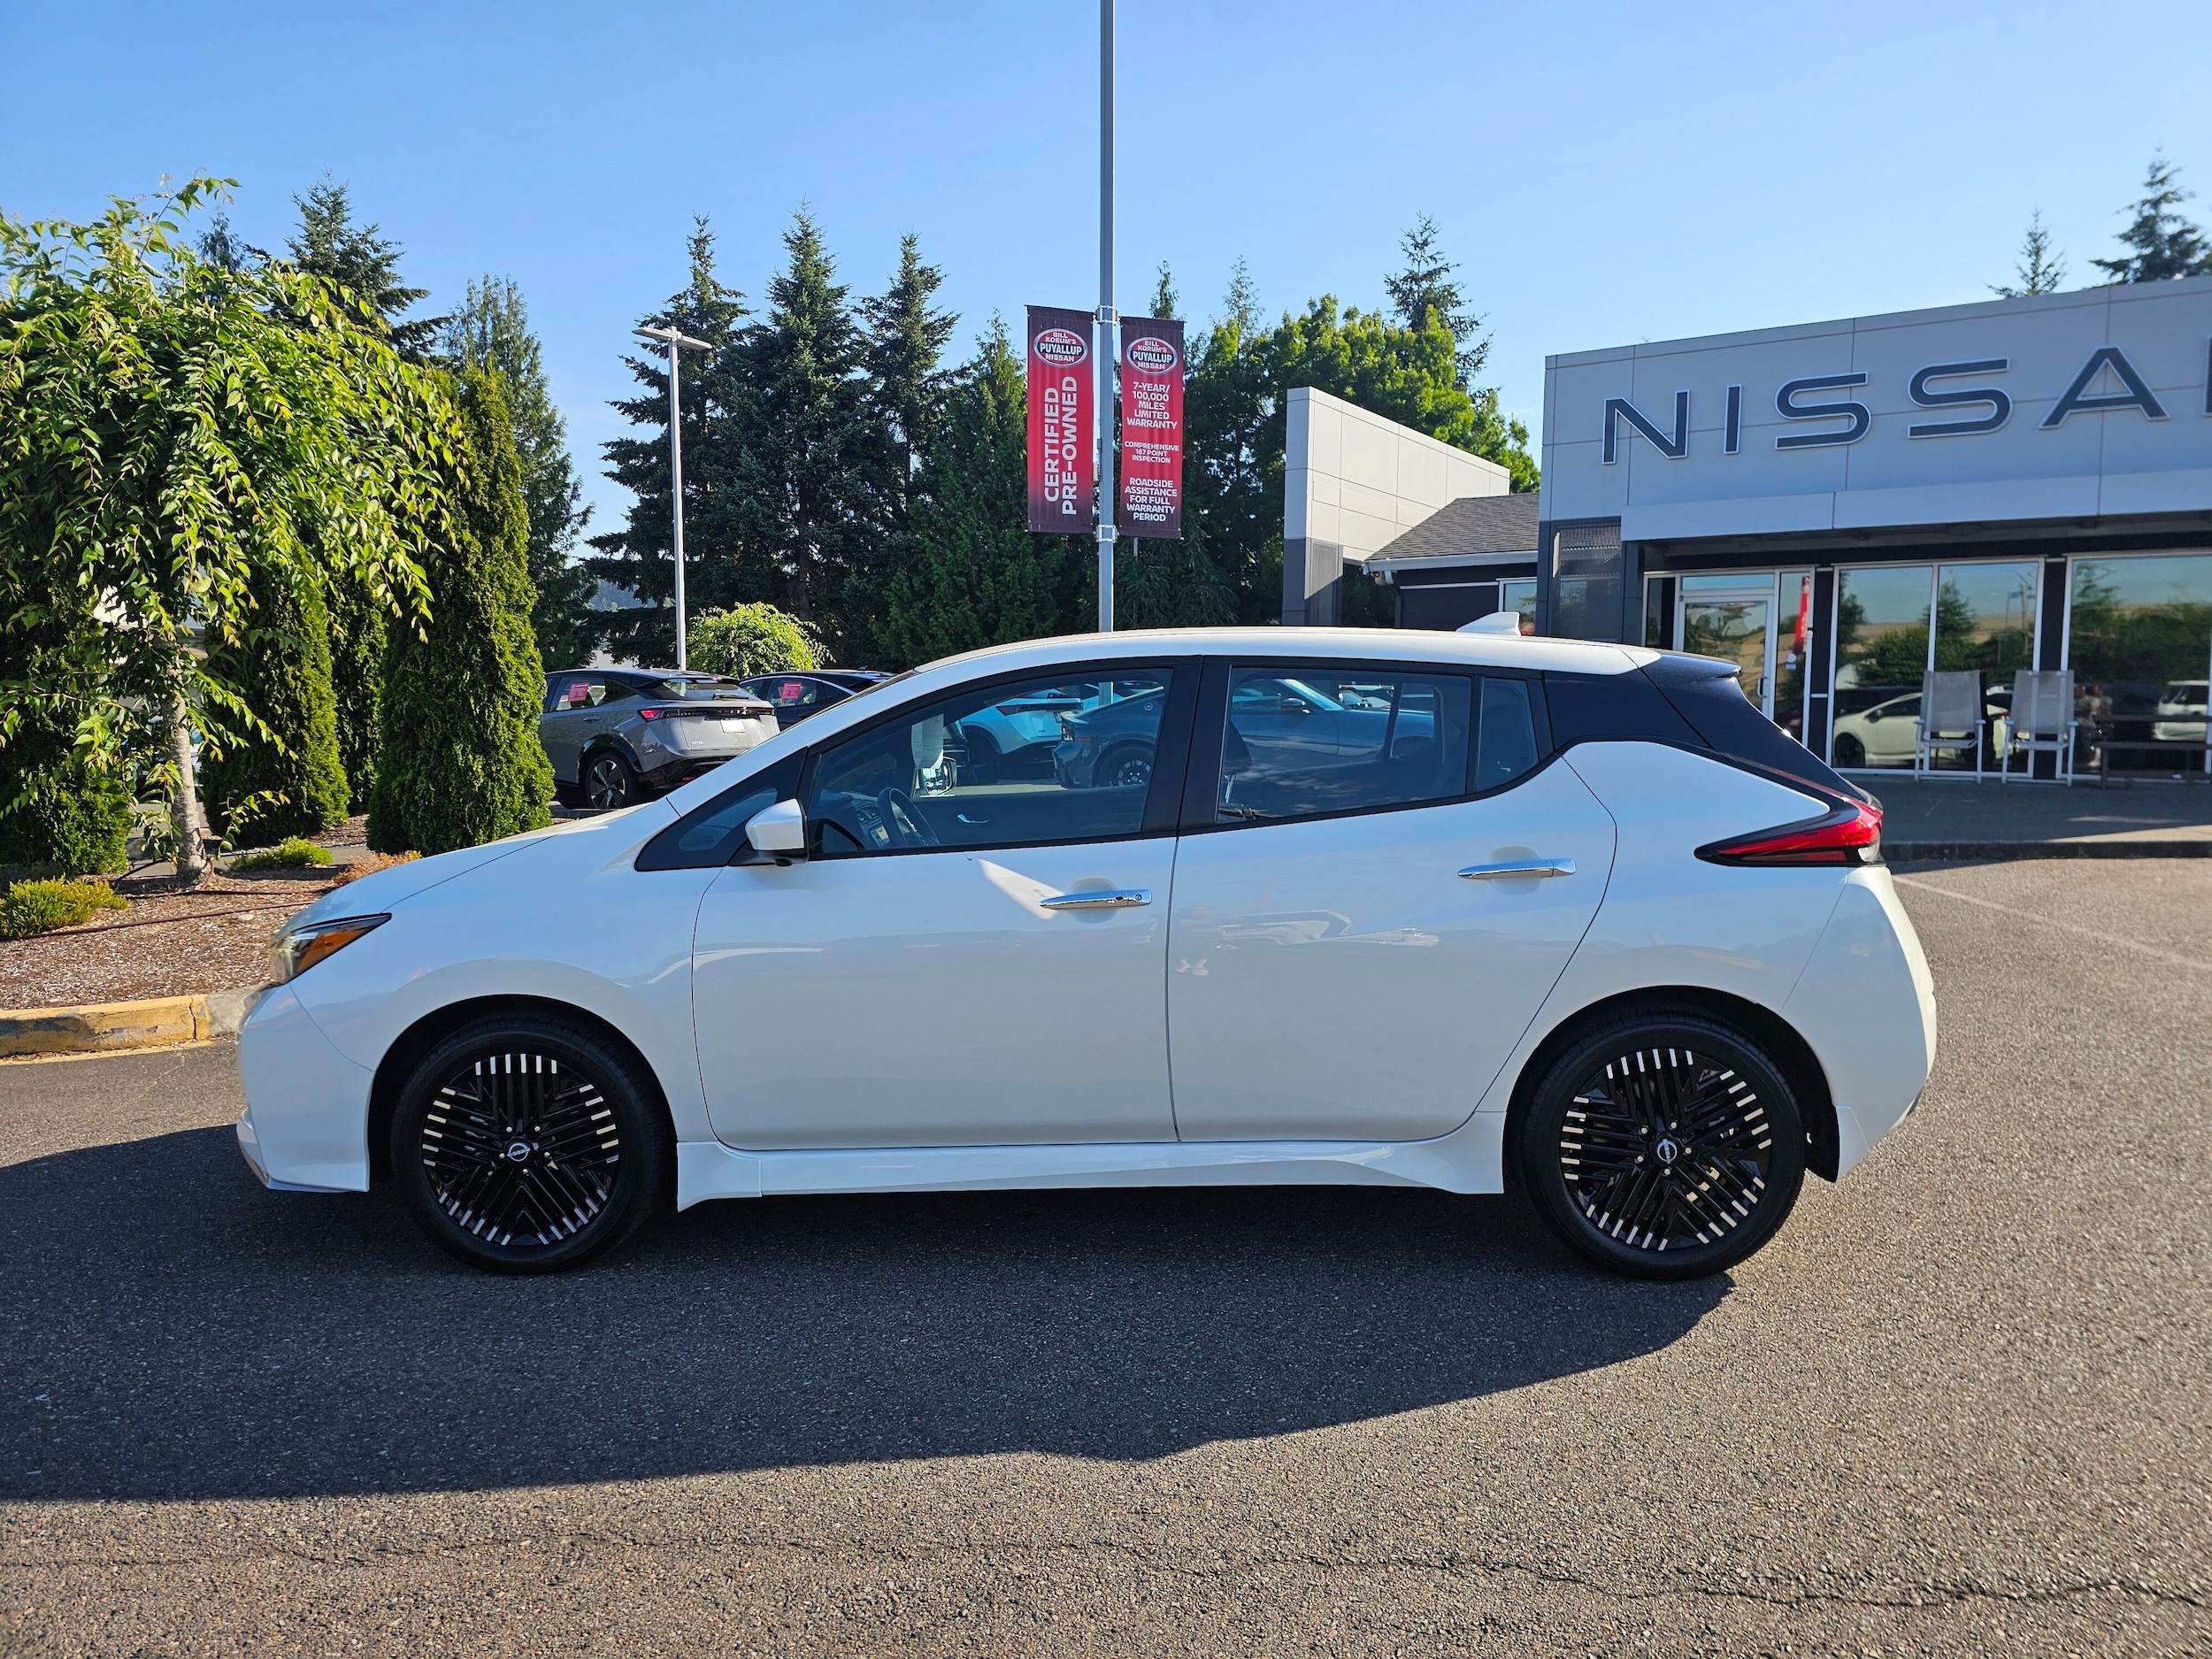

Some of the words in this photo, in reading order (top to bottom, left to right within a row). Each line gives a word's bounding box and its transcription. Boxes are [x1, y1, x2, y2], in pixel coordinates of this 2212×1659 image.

[1040, 342, 1082, 355] PUYALLUP
[1133, 351, 1172, 363] PUYALLUP
[1133, 381, 1170, 394] 7-YEAR/
[1133, 391, 1169, 402] 100,000
[1601, 334, 2212, 465] NISSA
[1138, 401, 1165, 411] MILES
[1134, 410, 1170, 419] LIMITED
[1126, 418, 1178, 429] WARRANTY
[1044, 388, 1059, 503] CERTIFIED
[1062, 376, 1078, 516] PRE-OWNED
[1125, 442, 1179, 451] COMPREHENSIVE
[1133, 455, 1171, 464] INSPECTION
[1129, 478, 1173, 488] ROADSIDE
[1125, 486, 1178, 497] ASSISTANCE
[1130, 495, 1148, 503] FOR
[1149, 496, 1171, 505] FULL
[1126, 503, 1176, 513] WARRANTY
[1133, 512, 1166, 522] PERIOD
